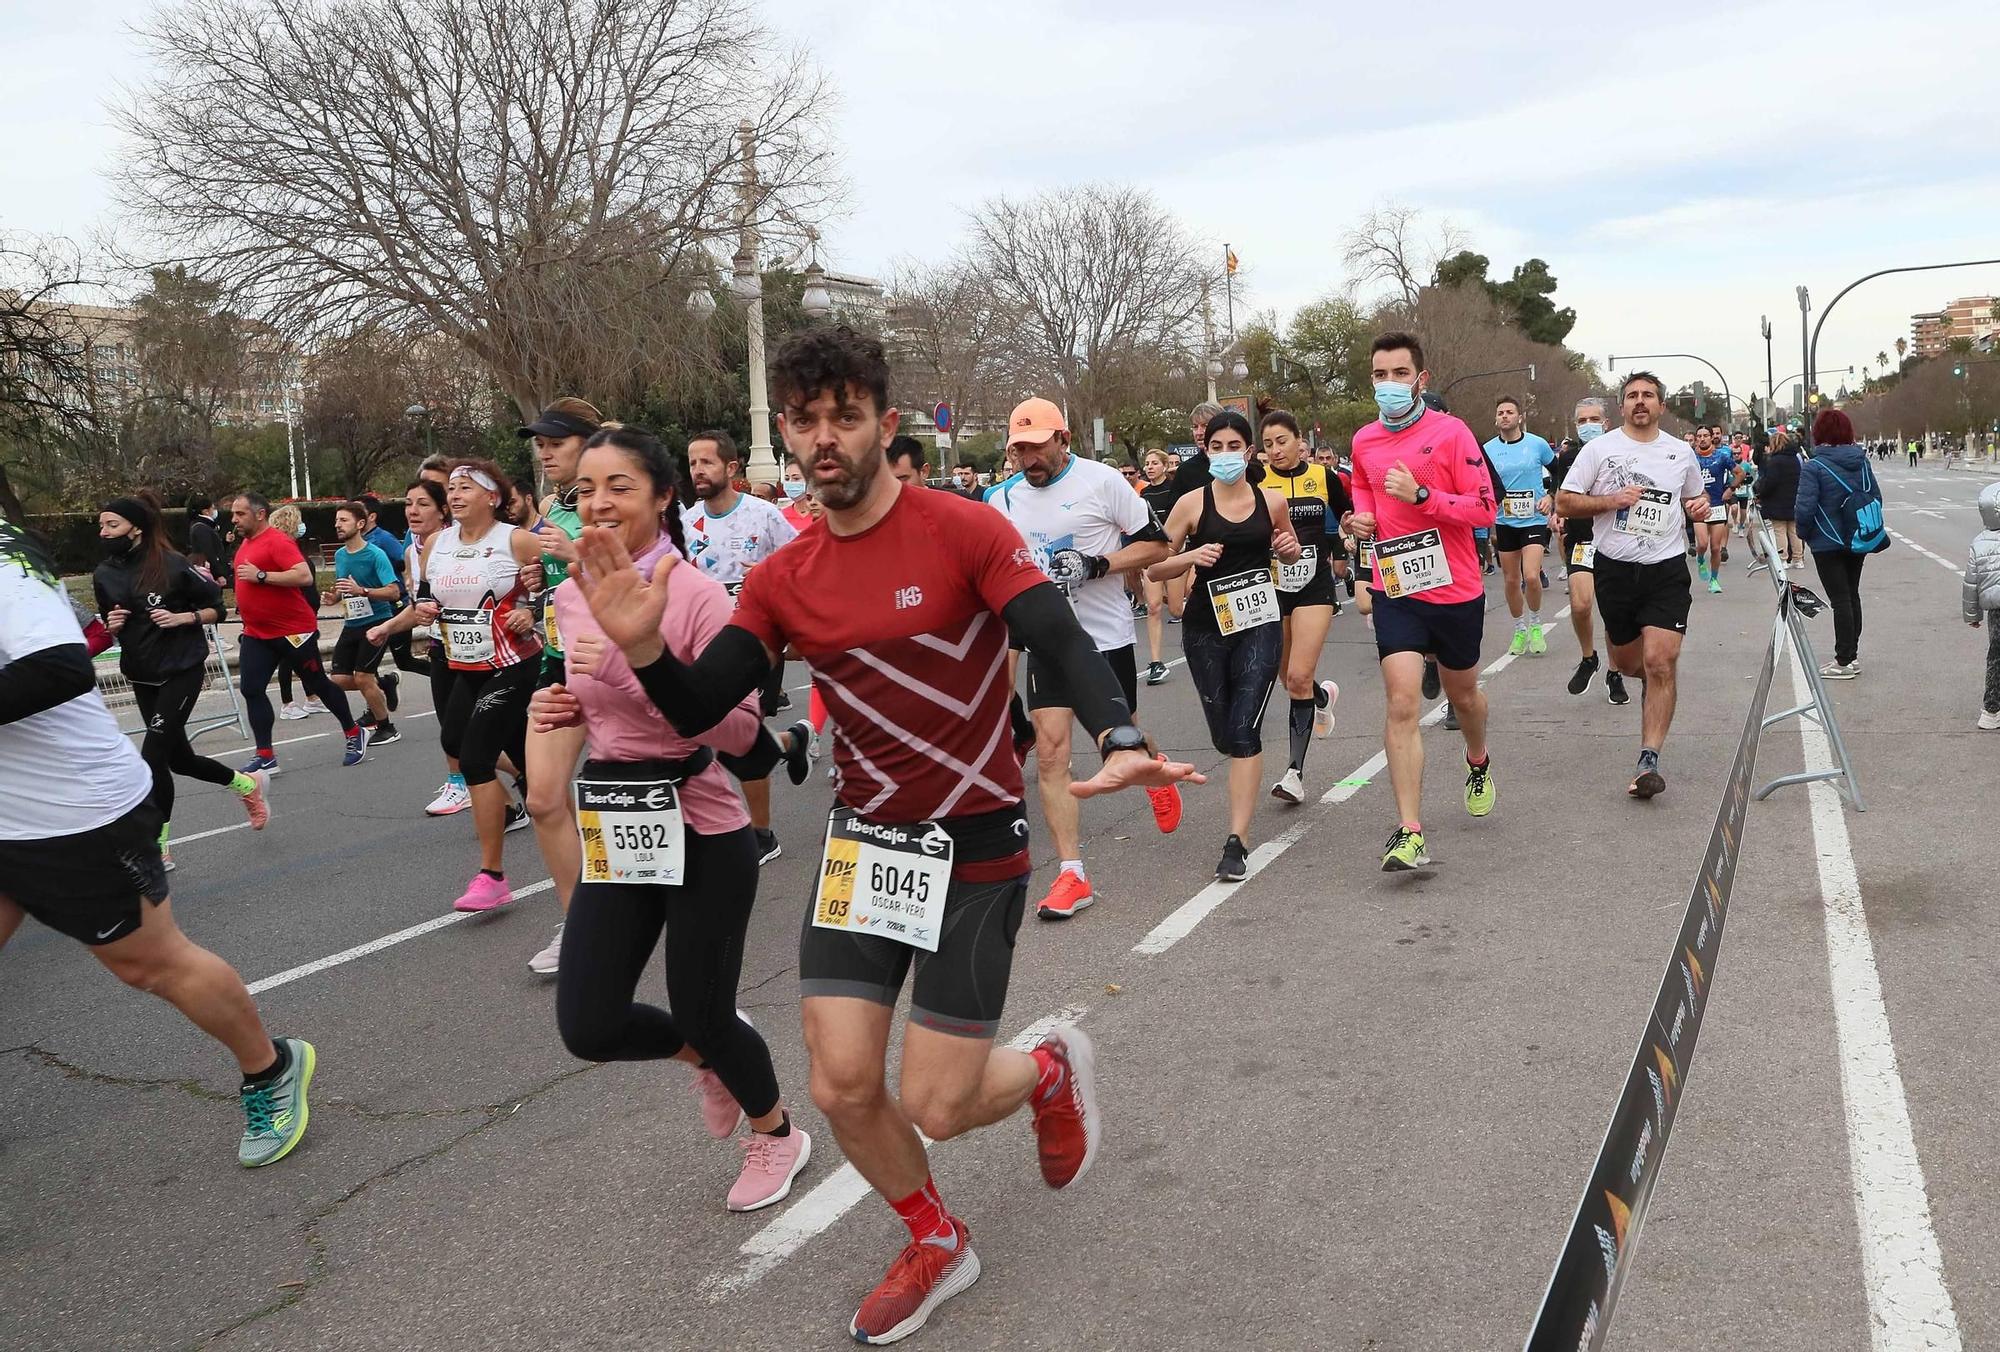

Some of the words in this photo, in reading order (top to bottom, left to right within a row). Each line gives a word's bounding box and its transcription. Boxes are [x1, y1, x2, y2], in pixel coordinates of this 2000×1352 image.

[1635, 506, 1662, 522] 4431
[1382, 541, 1416, 554] iberCaja
[1283, 564, 1309, 578] 5473
[1402, 554, 1435, 575] 6577
[1216, 578, 1249, 592] iberCaja
[1236, 590, 1267, 612] 6193
[453, 630, 482, 645] 6233
[584, 791, 636, 807] iberCaja
[613, 823, 669, 851] 5582
[846, 817, 908, 845] iberCaja
[634, 852, 655, 862] LOLA
[594, 859, 608, 873] 03
[871, 862, 931, 903] 6045
[828, 899, 850, 917] 03
[871, 895, 926, 919] OSCAR-VERO
